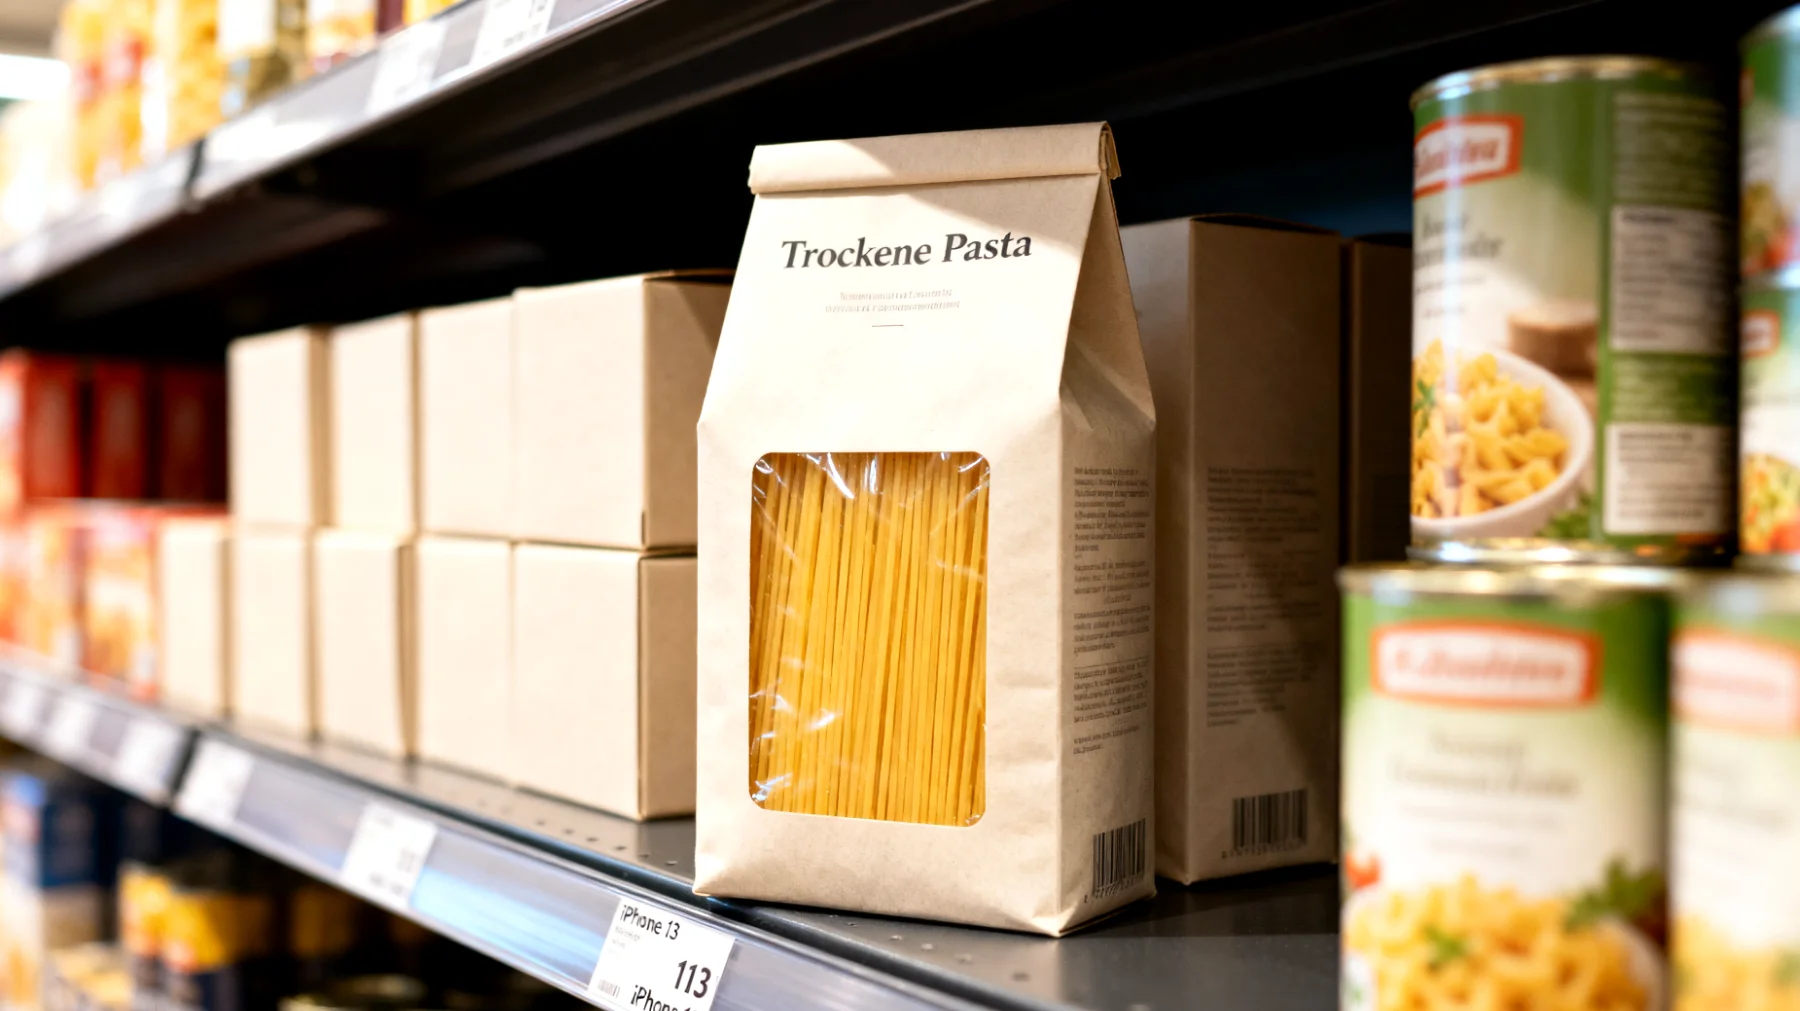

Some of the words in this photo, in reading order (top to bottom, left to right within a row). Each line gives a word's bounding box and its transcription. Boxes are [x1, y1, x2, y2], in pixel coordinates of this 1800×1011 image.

[781, 237, 932, 268] Trockene
[942, 232, 1032, 262] Pasta
[620, 905, 662, 935] iPhone
[665, 920, 680, 940] 13
[674, 960, 711, 998] 113
[631, 985, 678, 1011] iPhon
